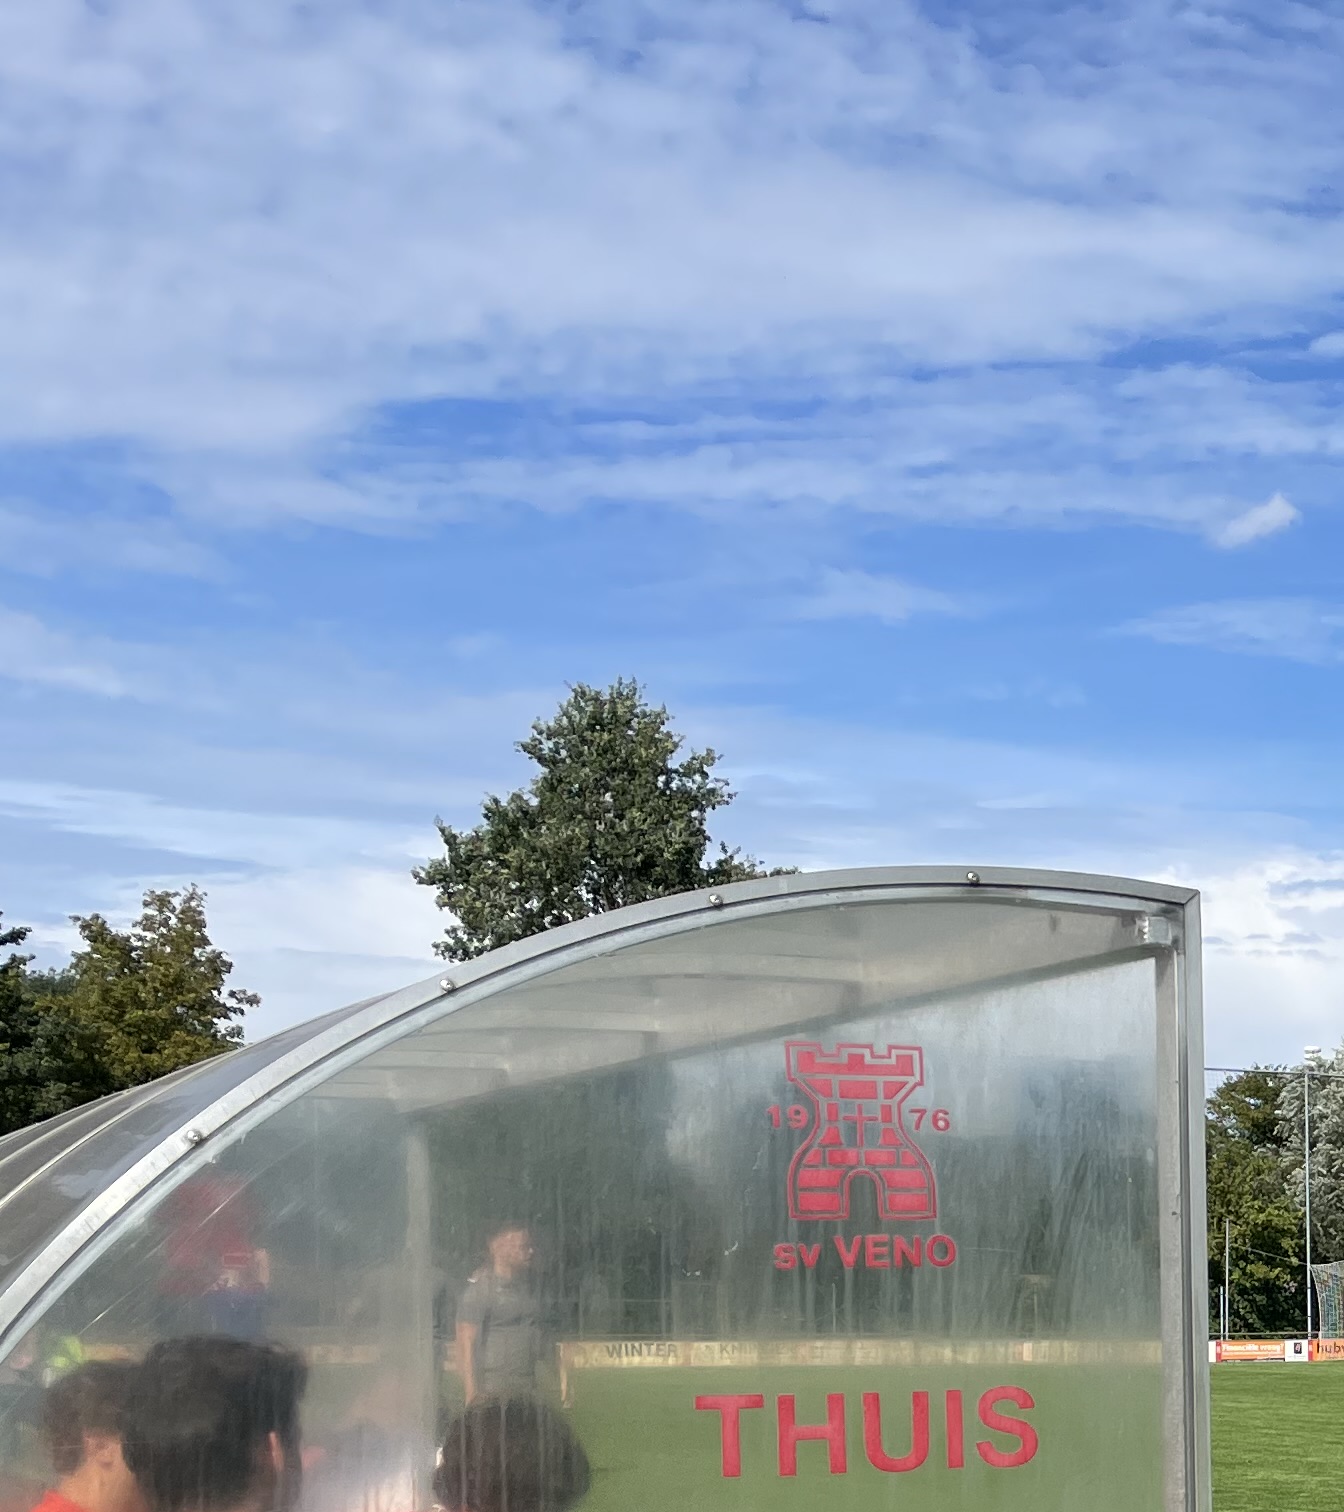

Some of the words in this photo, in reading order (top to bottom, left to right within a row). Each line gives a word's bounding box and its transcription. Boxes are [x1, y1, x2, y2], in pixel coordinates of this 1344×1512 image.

[767, 1103, 809, 1131] 19
[910, 1108, 951, 1132] 76
[834, 1233, 957, 1269] VENO
[606, 1342, 679, 1359] WINTER
[695, 1385, 1039, 1478] THUIS
